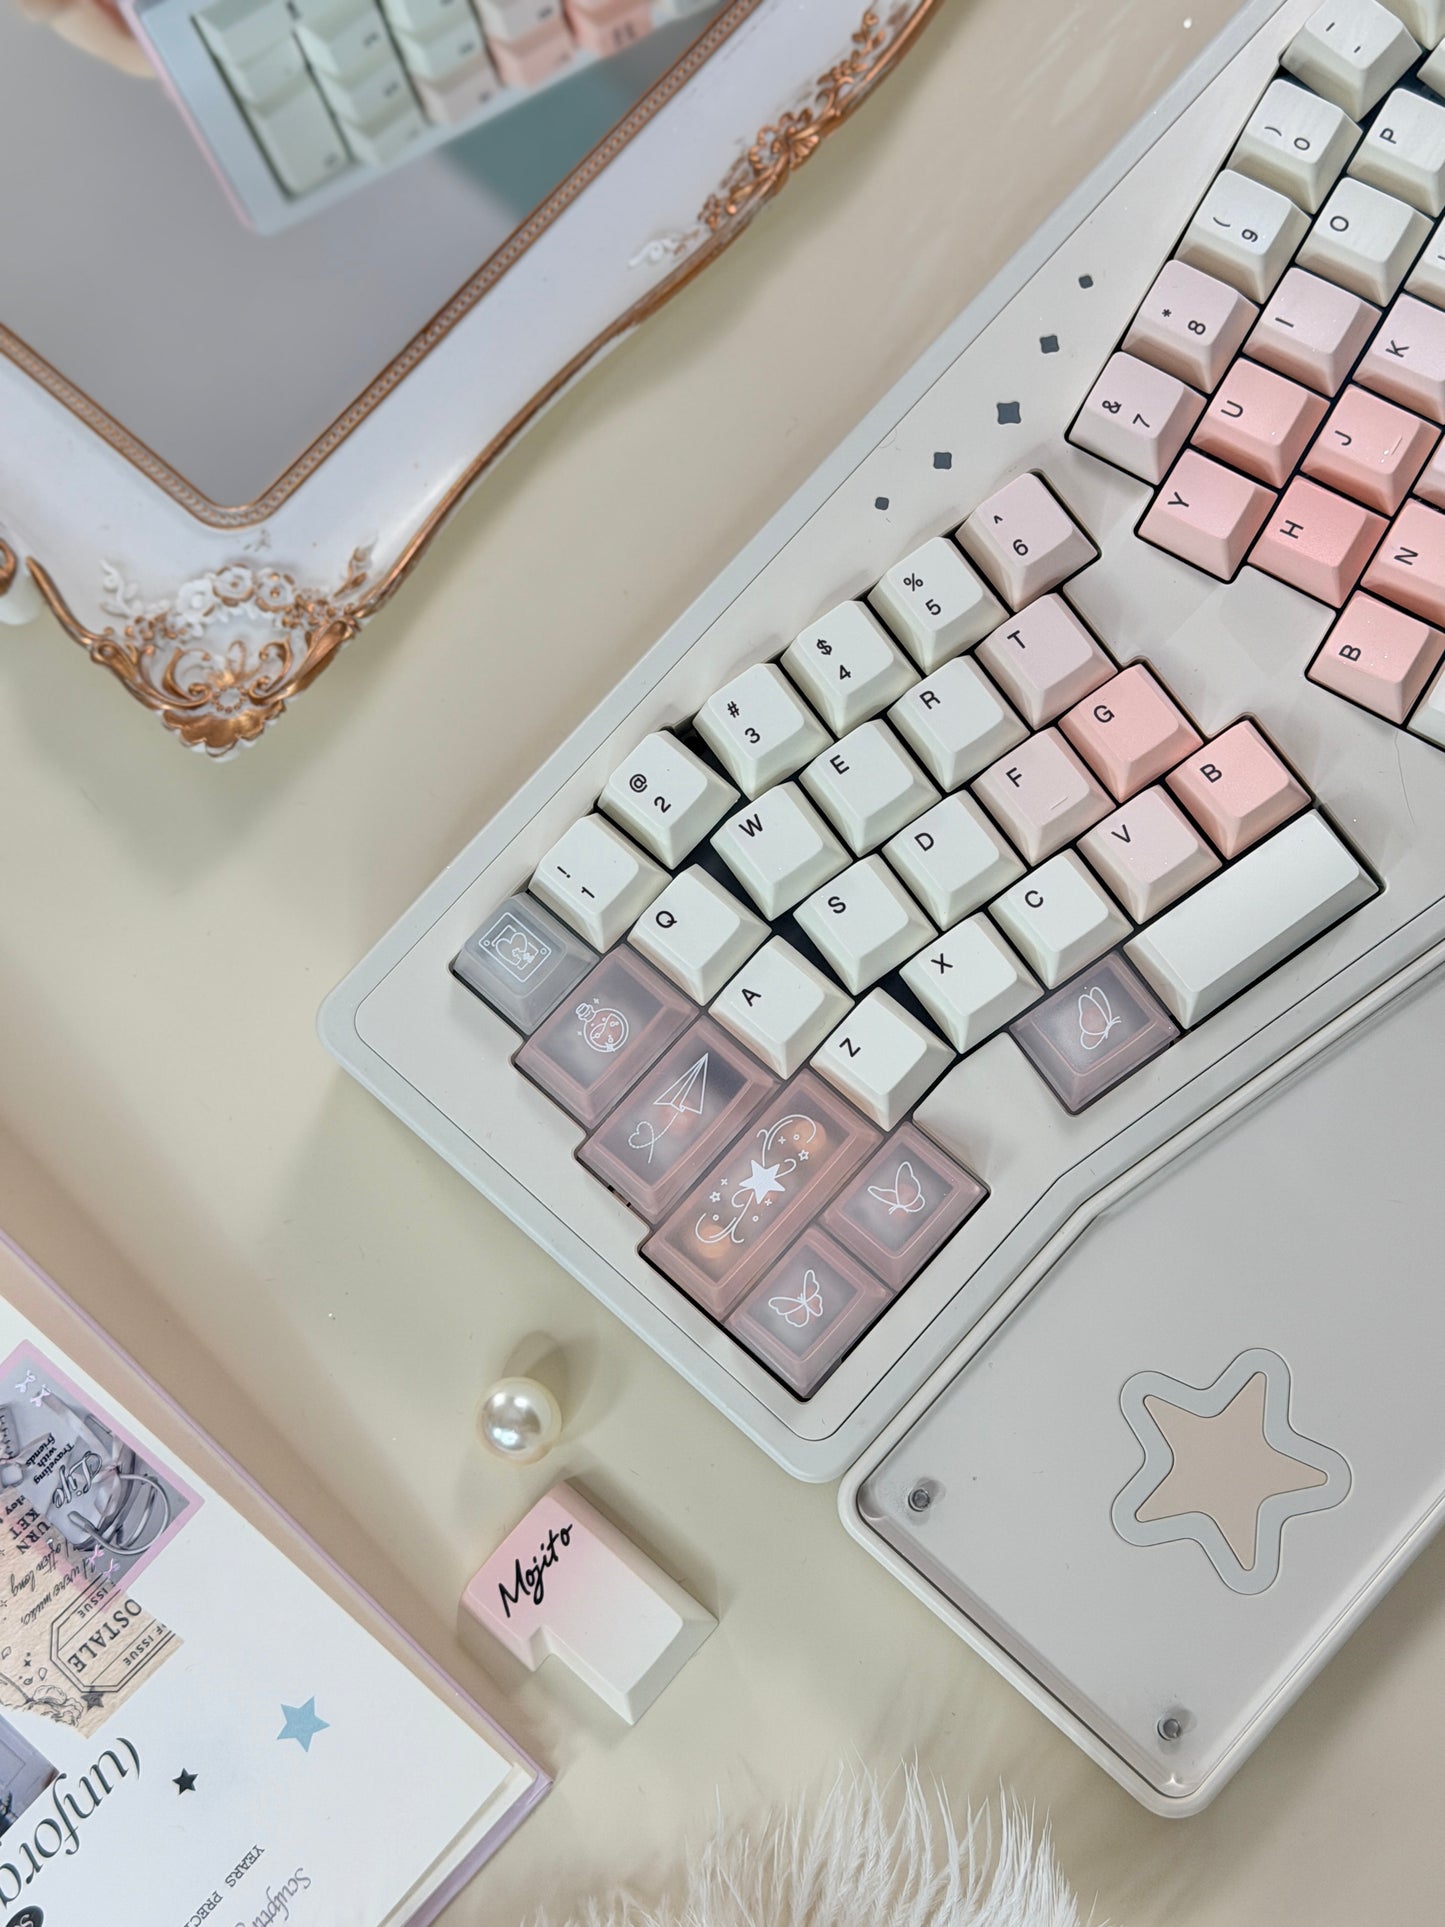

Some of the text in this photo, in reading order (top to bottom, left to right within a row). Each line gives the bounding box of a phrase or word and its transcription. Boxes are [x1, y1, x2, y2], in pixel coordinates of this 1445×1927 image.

[1264, 126, 1282, 137] )
[1379, 127, 1397, 145] P
[1212, 216, 1231, 228] (
[1330, 215, 1349, 232] O
[1241, 228, 1259, 243] 9
[1187, 319, 1207, 336] 8
[1385, 340, 1410, 358] K
[1101, 400, 1122, 415] &
[1220, 400, 1244, 418] U
[1132, 413, 1150, 428] 7
[1334, 430, 1352, 446] J
[1167, 492, 1190, 510] Y
[993, 515, 1004, 525] ^
[1279, 519, 1304, 539] H
[1012, 538, 1029, 557] 6
[1393, 546, 1419, 566] N
[903, 572, 924, 592] %
[925, 598, 942, 616] 5
[816, 638, 833, 656] $
[1006, 629, 1026, 649] T
[1338, 644, 1362, 662] B
[839, 664, 852, 680] 4
[727, 700, 740, 719] #
[919, 690, 940, 710] R
[1093, 704, 1115, 724] G
[744, 727, 761, 744] 3
[829, 755, 850, 775] E
[1199, 763, 1224, 783] B
[629, 773, 648, 794] @
[1005, 767, 1023, 788] F
[653, 795, 672, 814] 2
[738, 814, 763, 837] W
[1111, 824, 1131, 843] V
[914, 832, 935, 852] D
[556, 866, 571, 879] !
[581, 886, 595, 899] 1
[1024, 889, 1044, 909] C
[827, 896, 847, 914] S
[655, 910, 678, 929] Q
[931, 953, 953, 974] X
[741, 988, 762, 1007] A
[839, 1038, 861, 1058] Z
[26, 1432, 55, 1467] friends
[37, 1447, 57, 1468] with
[33, 1443, 75, 1485] Traveling
[52, 1450, 102, 1509] Life
[16, 1521, 52, 1555] URN
[498, 1523, 573, 1619] Mojito
[78, 1587, 108, 1618] ISSUE
[123, 1635, 154, 1666] ISSUE
[224, 1844, 265, 1888] YEARS
